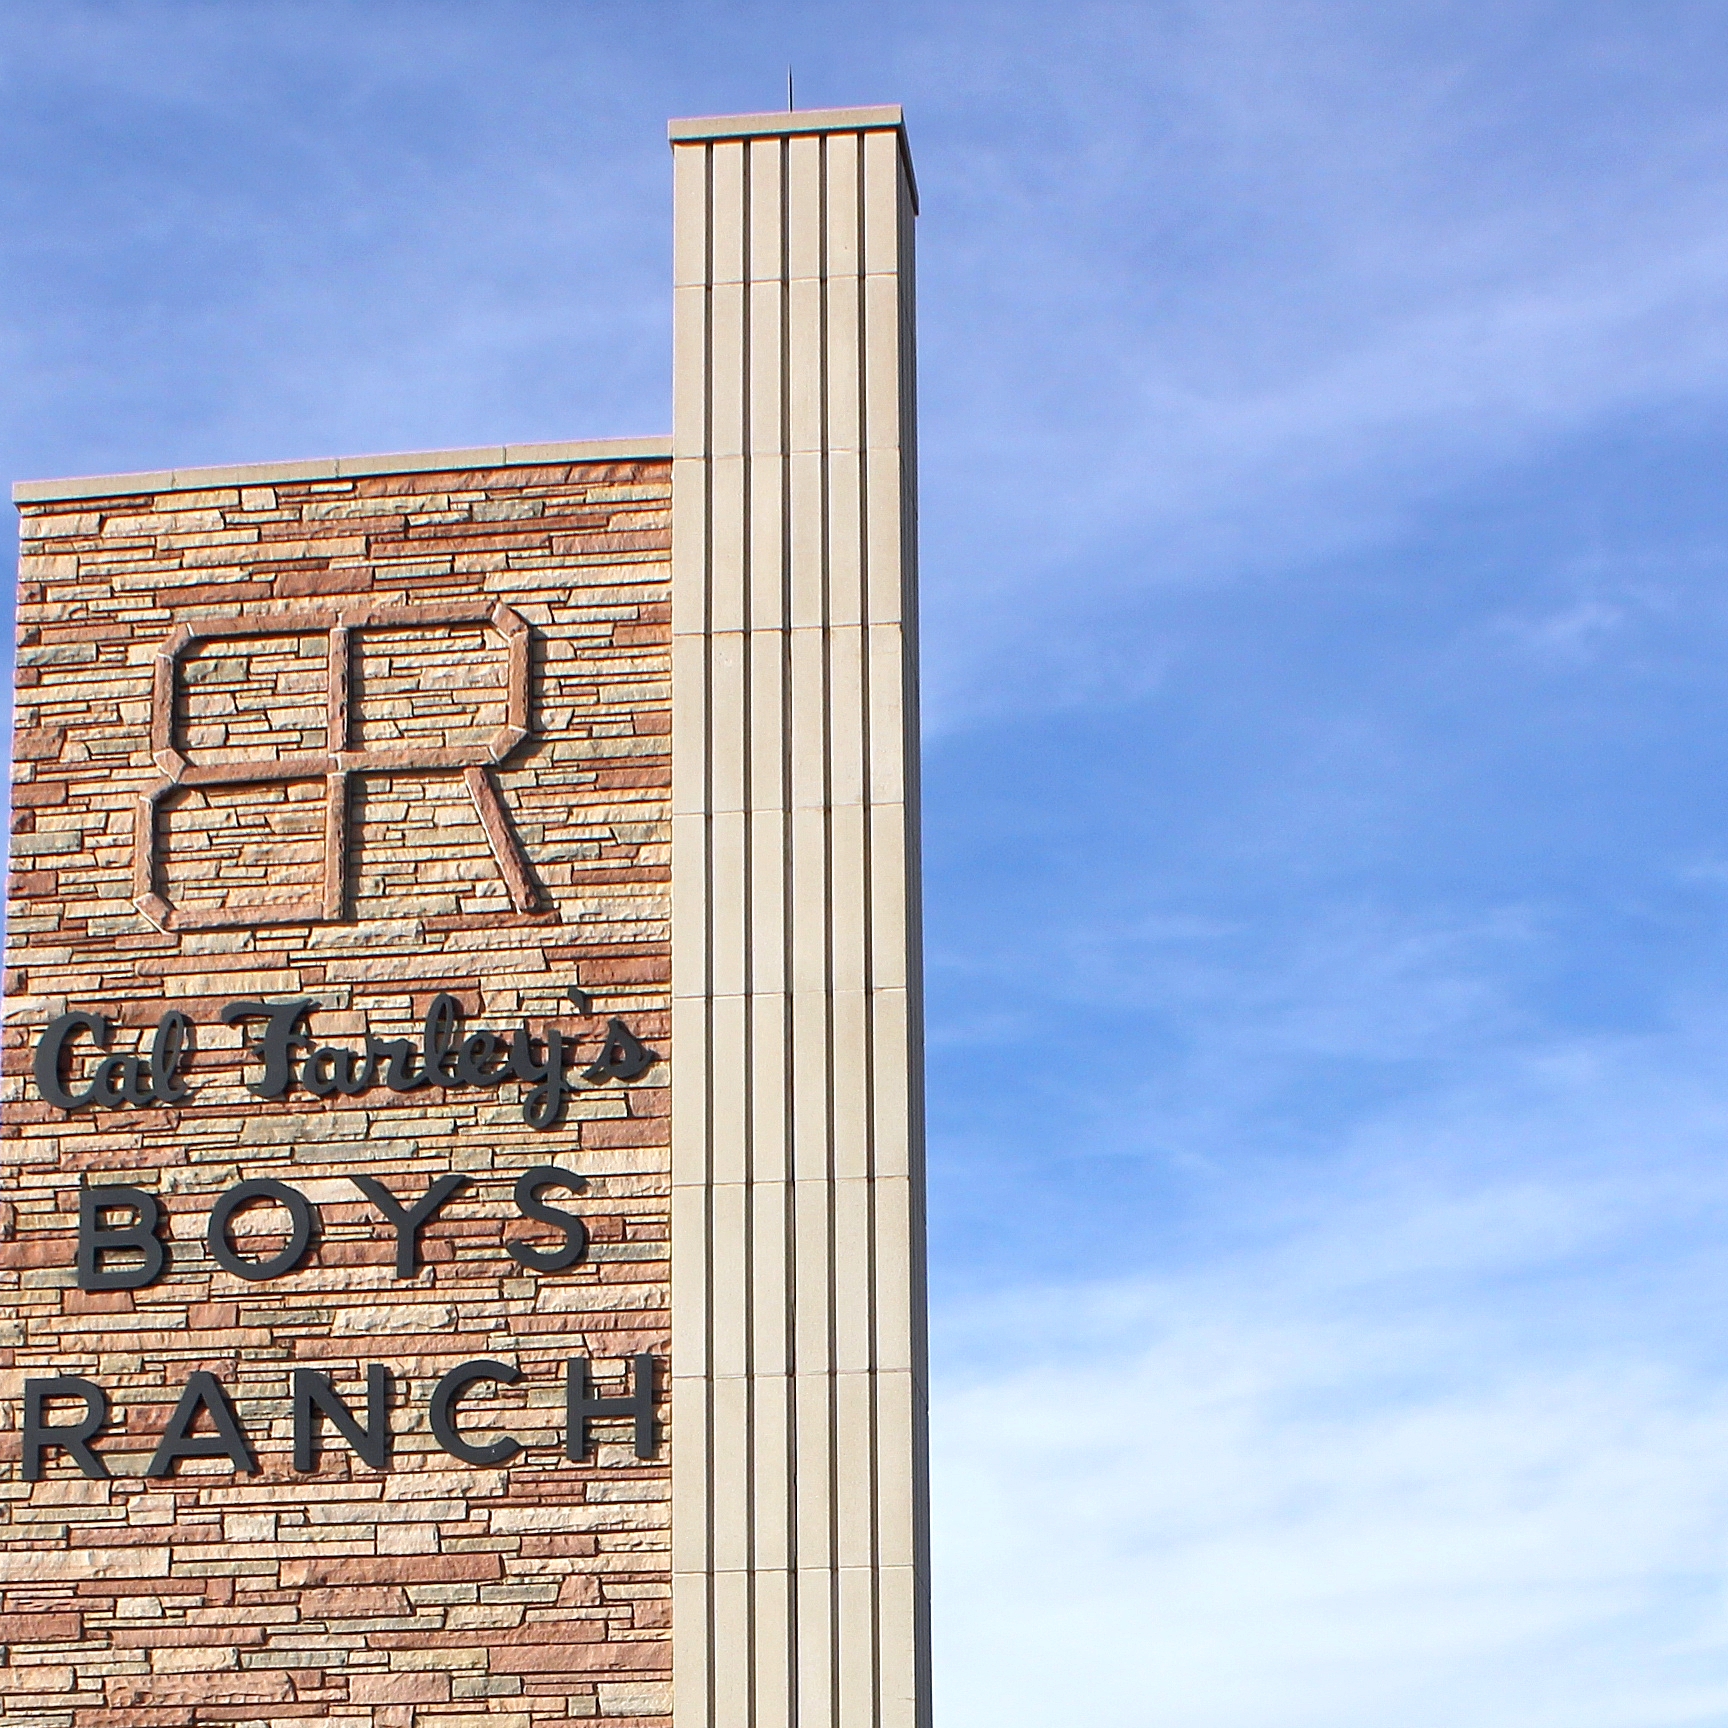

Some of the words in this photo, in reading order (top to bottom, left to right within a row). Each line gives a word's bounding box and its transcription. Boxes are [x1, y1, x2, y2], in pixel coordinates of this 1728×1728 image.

[33, 1008, 194, 1111] Cal
[222, 988, 656, 1131] Farley's
[76, 1165, 590, 1292] BOYS
[21, 1352, 659, 1483] RANCH
